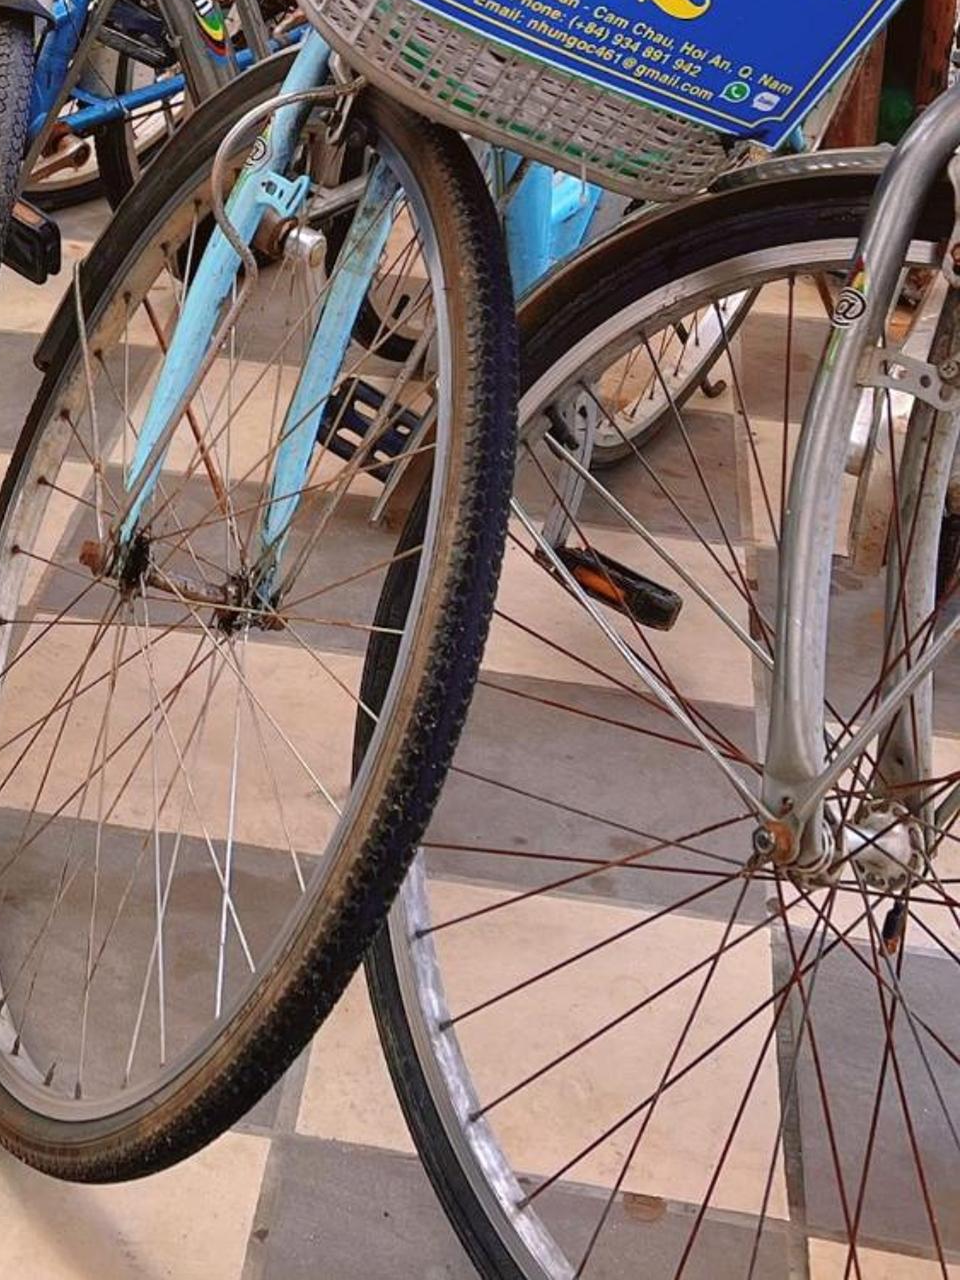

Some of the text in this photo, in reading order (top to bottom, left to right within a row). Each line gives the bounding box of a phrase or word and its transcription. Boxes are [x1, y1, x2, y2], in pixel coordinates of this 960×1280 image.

[526, 18, 715, 102] nhungoc461@gmail.com
[568, 14, 611, 43] (+84)
[611, 32, 642, 54] 934
[642, 45, 672, 66] 891
[673, 58, 703, 79] 942
[593, 6, 628, 29] Cam
[632, 22, 675, 51] Chau,
[679, 41, 708, 62] Hoi
[758, 73, 794, 96] Nam
